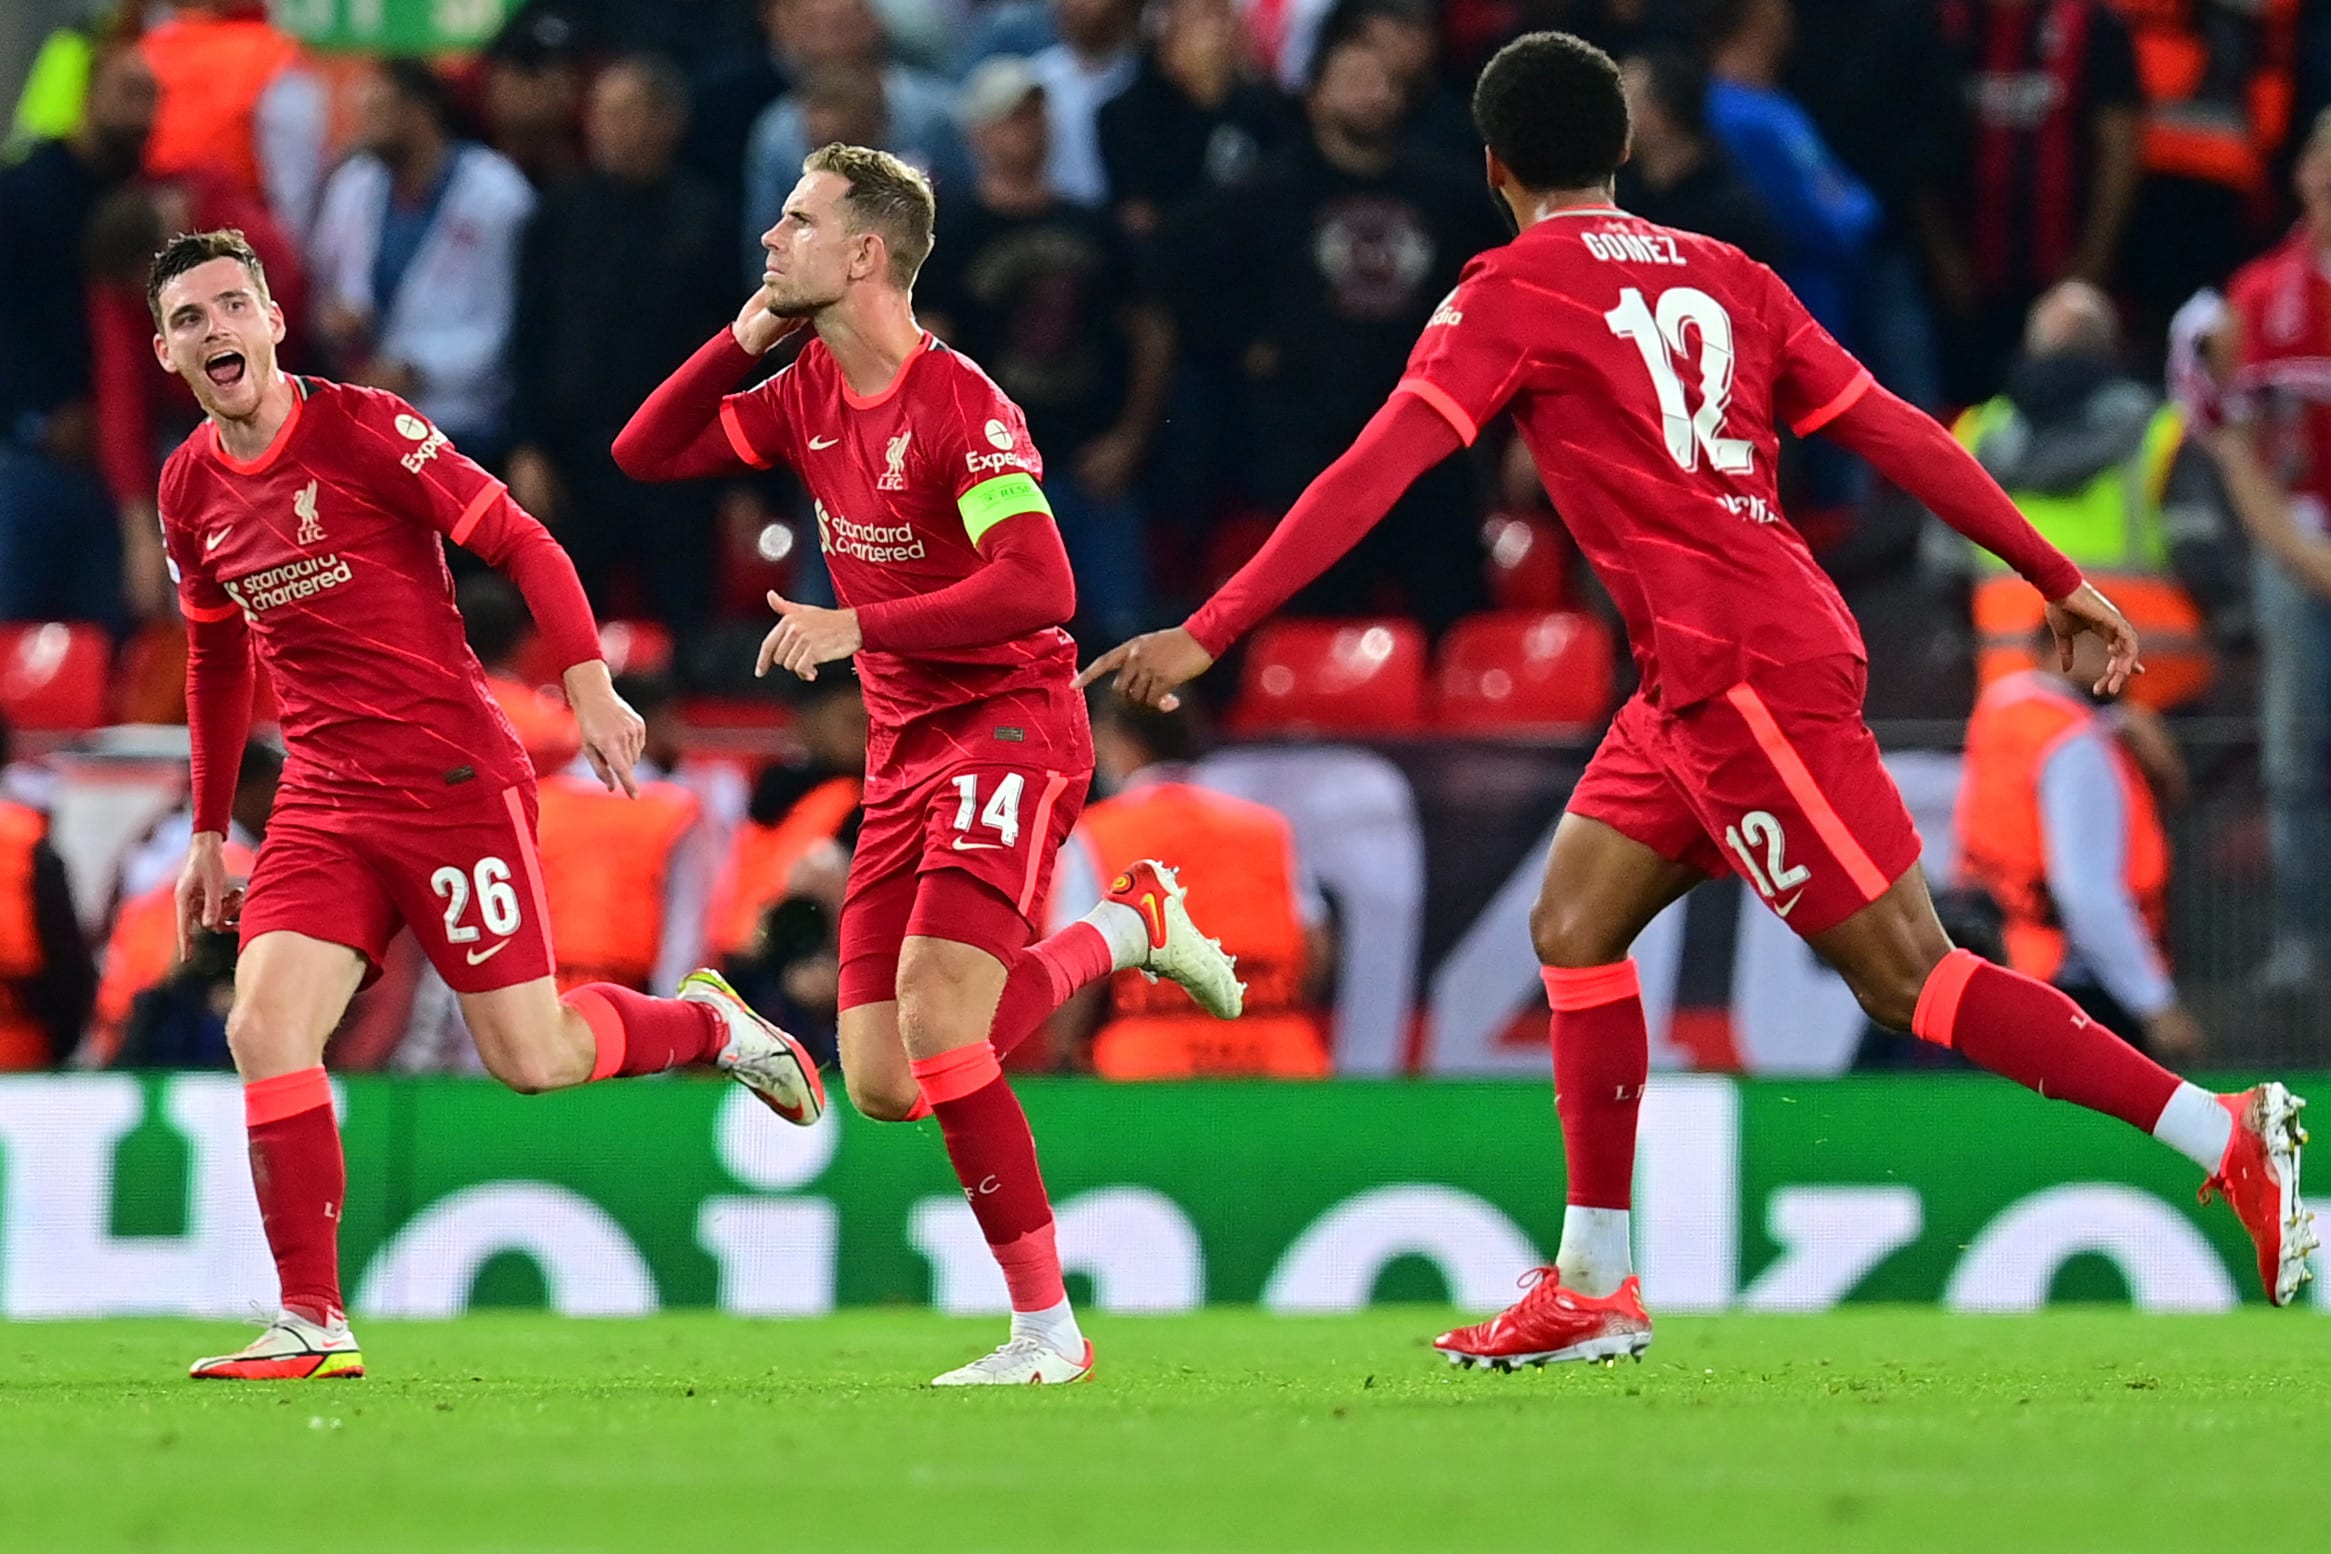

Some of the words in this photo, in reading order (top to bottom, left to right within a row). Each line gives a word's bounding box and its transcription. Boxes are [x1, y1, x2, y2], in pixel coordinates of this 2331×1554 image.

[1581, 232, 1687, 266] GOMEZ
[1604, 287, 1754, 474] 12
[876, 476, 904, 490] LFC
[297, 526, 328, 545] LFC
[252, 560, 352, 611] chartered
[951, 772, 1025, 848] 14
[1726, 810, 1812, 897] 12
[430, 856, 522, 944] 26
[0, 1074, 2331, 1316] Heineke
